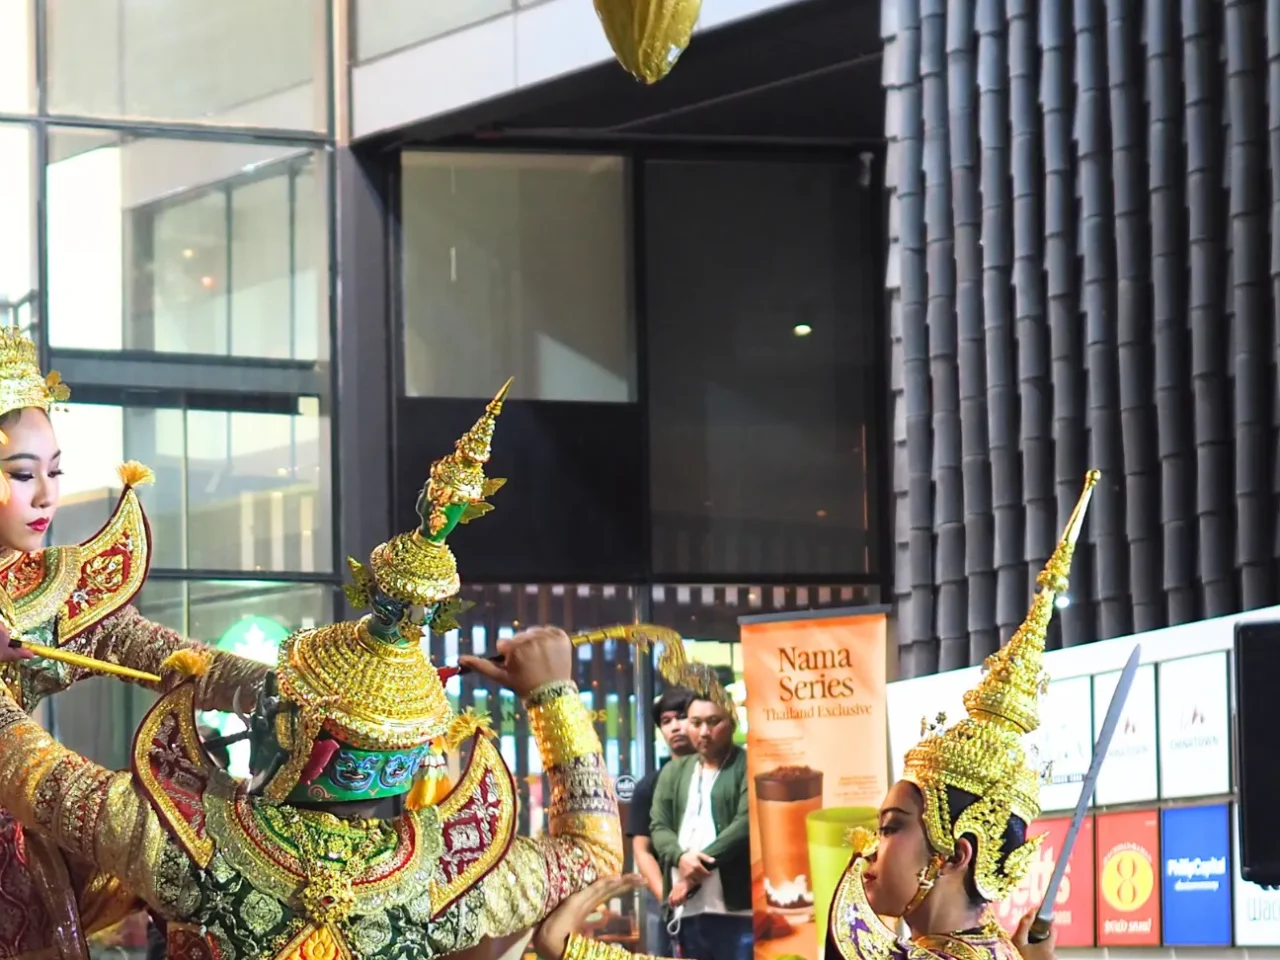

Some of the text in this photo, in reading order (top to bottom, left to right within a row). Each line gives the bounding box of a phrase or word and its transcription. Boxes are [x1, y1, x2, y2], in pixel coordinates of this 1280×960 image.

[778, 647, 853, 673] Nama
[778, 674, 855, 701] Series
[762, 703, 873, 721] Thailand Exclusive
